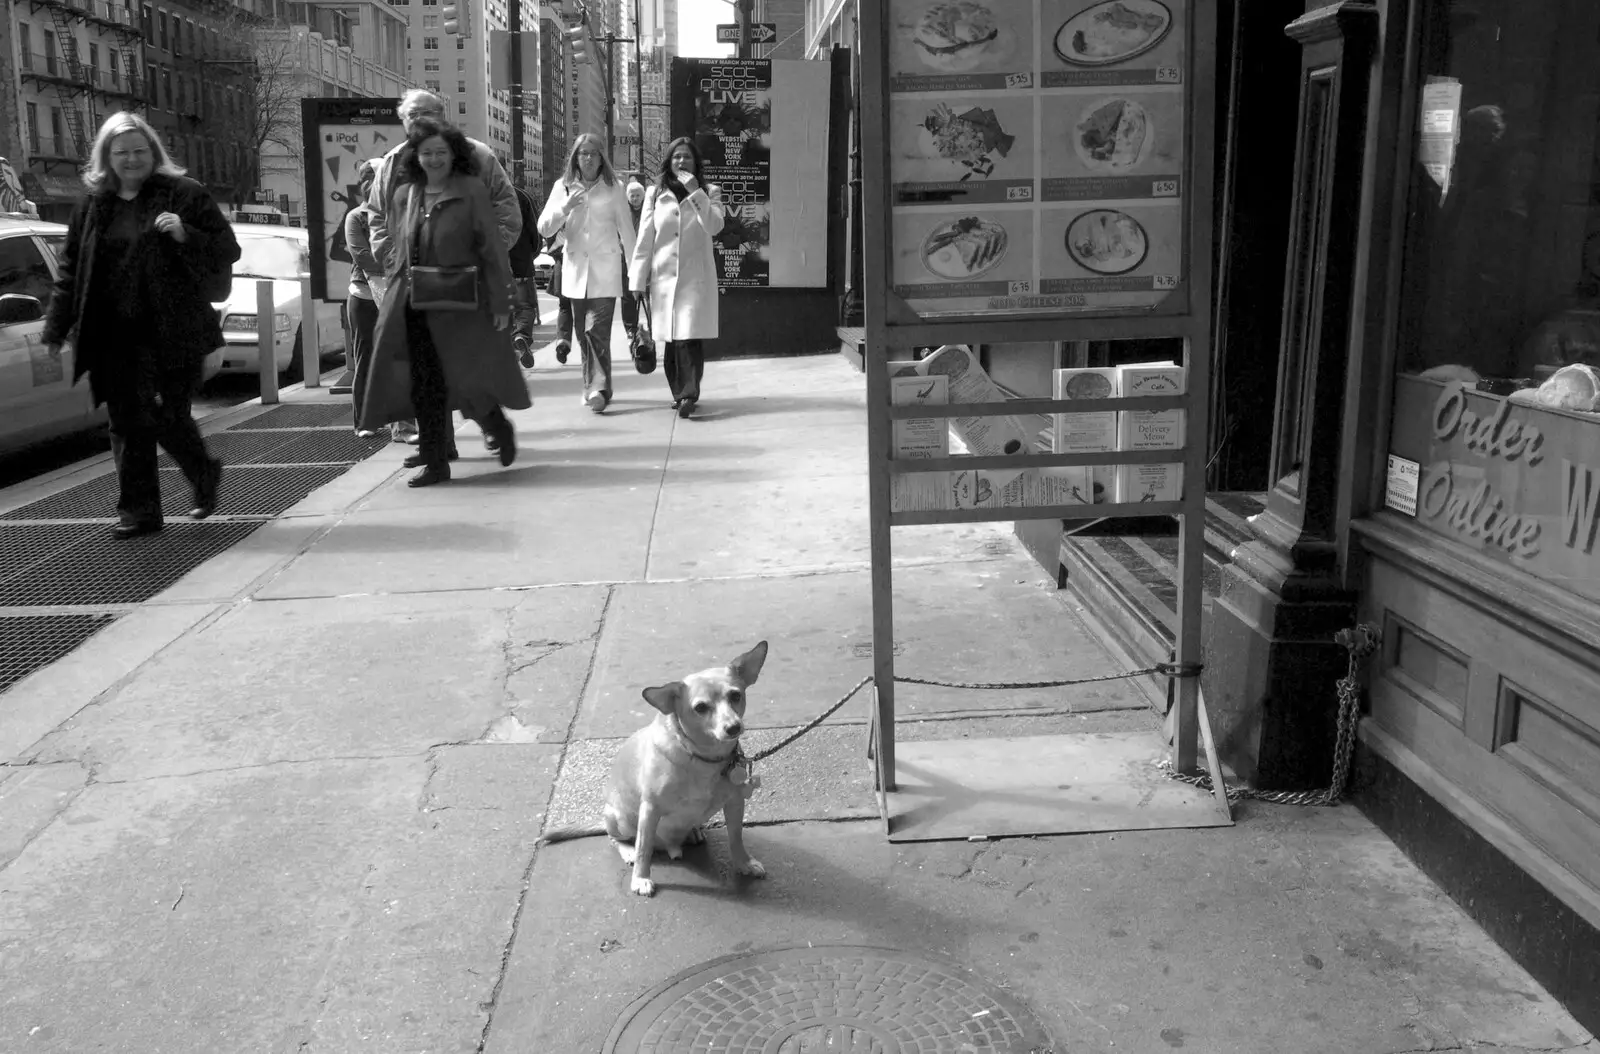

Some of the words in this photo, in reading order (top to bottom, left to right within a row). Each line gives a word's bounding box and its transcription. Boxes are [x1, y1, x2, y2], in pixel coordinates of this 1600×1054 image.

[724, 29, 740, 38] ONE
[752, 29, 769, 38] WAY
[710, 90, 756, 104] LIVE
[360, 106, 392, 115] verion
[336, 132, 359, 143] iPod
[248, 213, 269, 224] 7M83
[1138, 424, 1171, 434] Delivery
[1433, 381, 1543, 467] Order
[1143, 433, 1166, 441] Menu
[1422, 460, 1542, 560] Online
